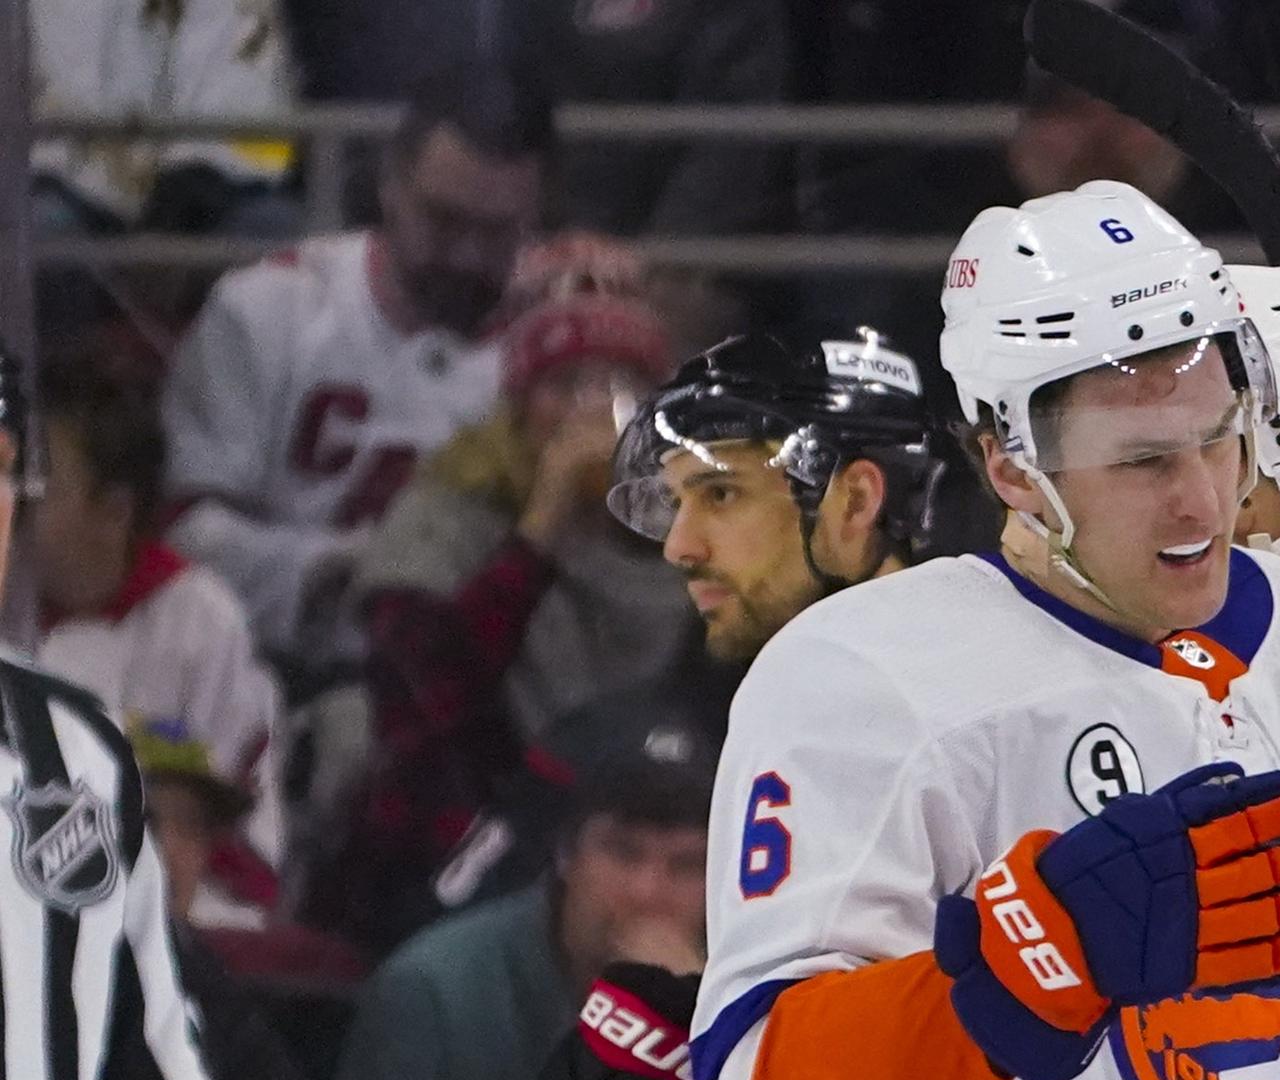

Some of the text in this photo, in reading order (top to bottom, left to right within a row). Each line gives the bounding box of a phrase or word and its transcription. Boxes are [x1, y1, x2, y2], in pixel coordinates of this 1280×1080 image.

[1099, 218, 1135, 244] 6
[950, 258, 979, 288] UBS
[1111, 279, 1188, 308] BAUER
[1091, 740, 1129, 807] 9
[42, 815, 100, 882] NHL
[740, 771, 792, 901] 6
